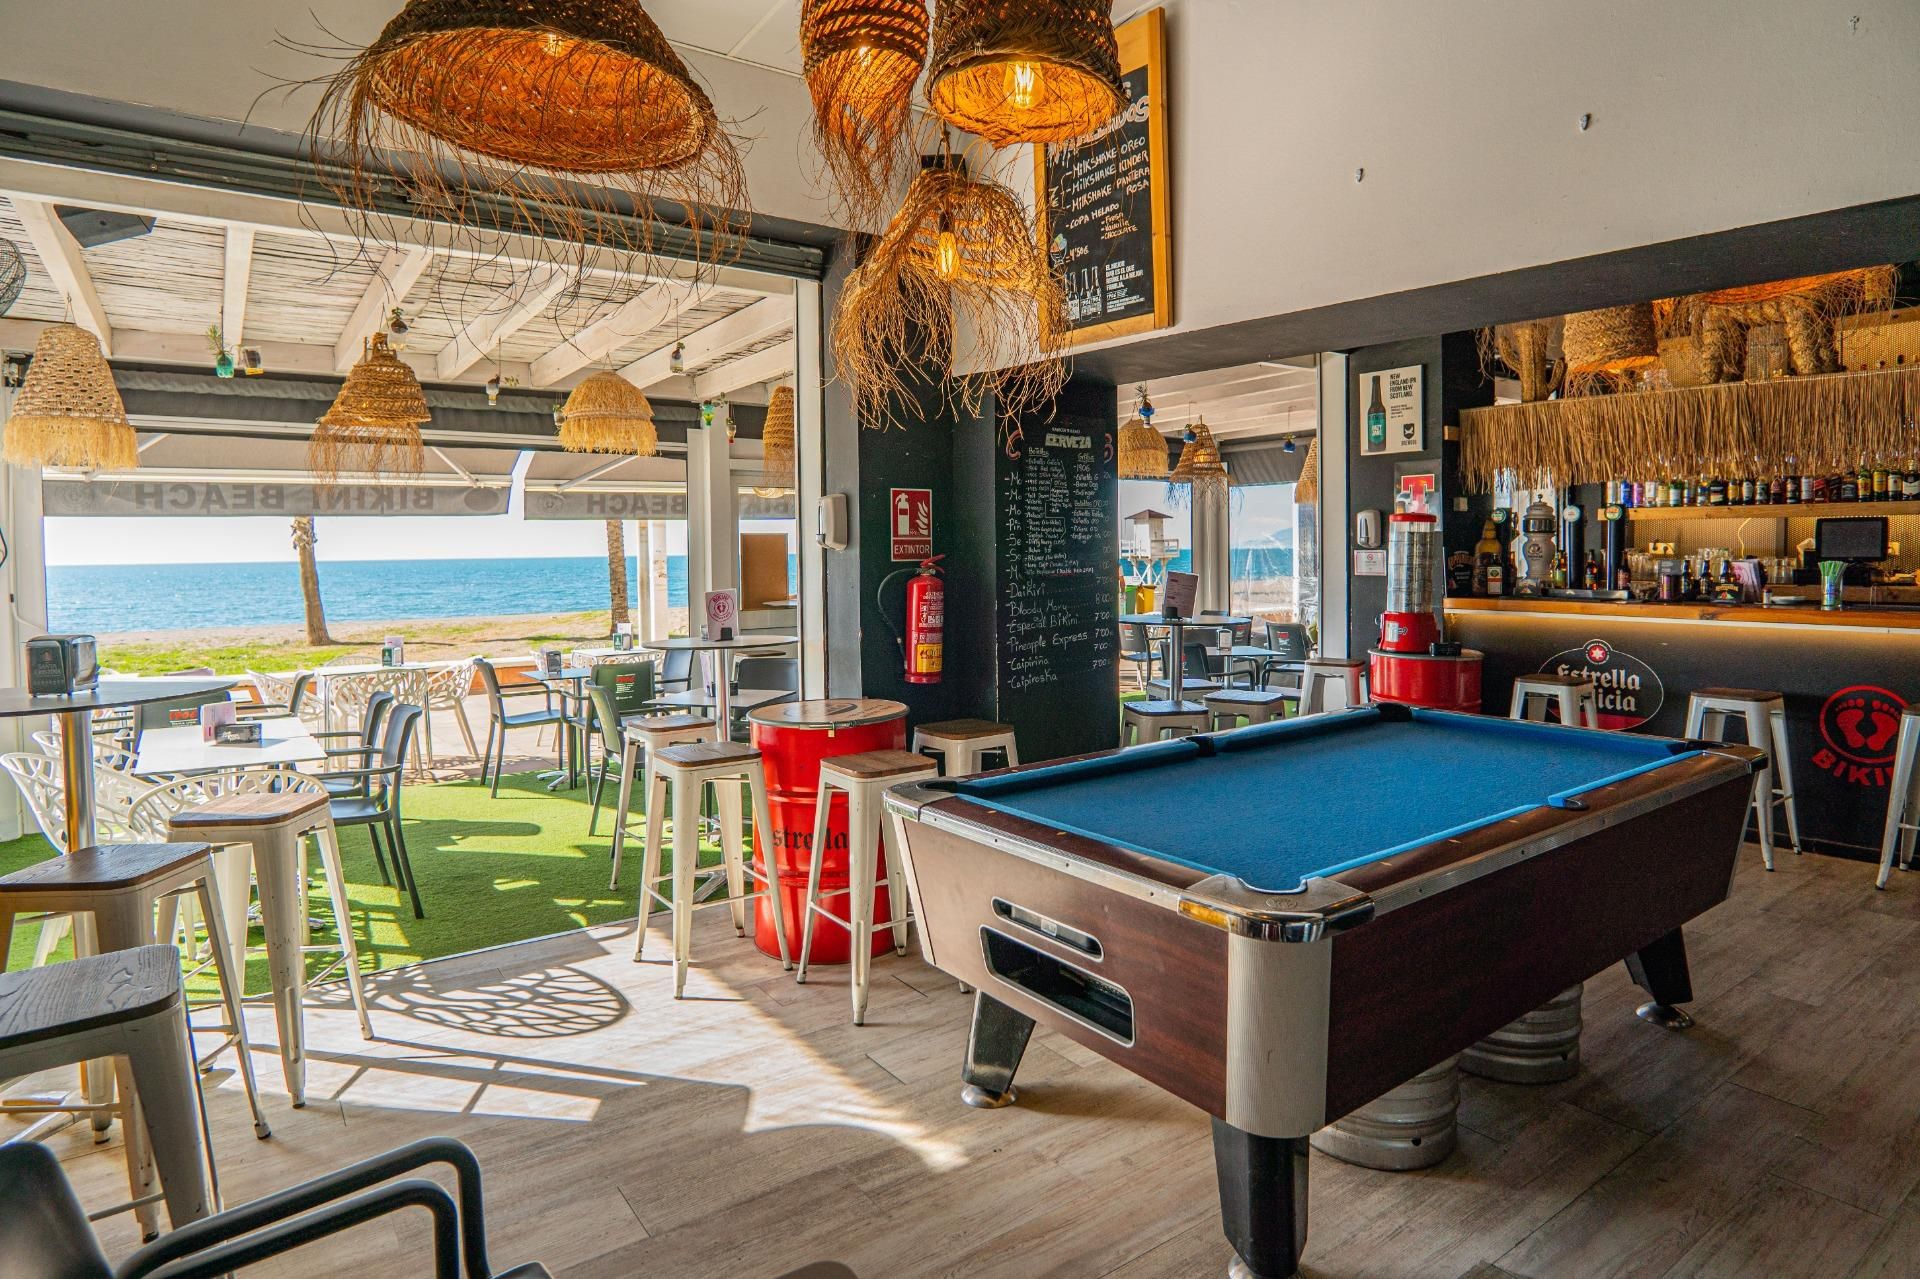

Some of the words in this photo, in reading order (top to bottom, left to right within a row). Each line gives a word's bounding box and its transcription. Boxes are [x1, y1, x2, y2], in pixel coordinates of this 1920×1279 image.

[1120, 136, 1146, 155] OREO
[1118, 150, 1149, 173] KINDER
[1126, 178, 1150, 196] ROSA
[1069, 214, 1090, 230] COPA
[1091, 203, 1120, 220] HELADO
[1389, 378, 1409, 387] ENGLAND
[1409, 376, 1417, 384] IPA
[1402, 383, 1413, 391] NEW
[1045, 432, 1092, 449] CERVEZA
[893, 543, 930, 555] EXTINTOR
[1009, 617, 1047, 636] Especial
[1009, 635, 1047, 654] Pineapple
[1052, 632, 1088, 651] Express
[1594, 688, 1638, 712] icia
[1811, 747, 1895, 787] BIKI
[771, 825, 850, 850] strela
